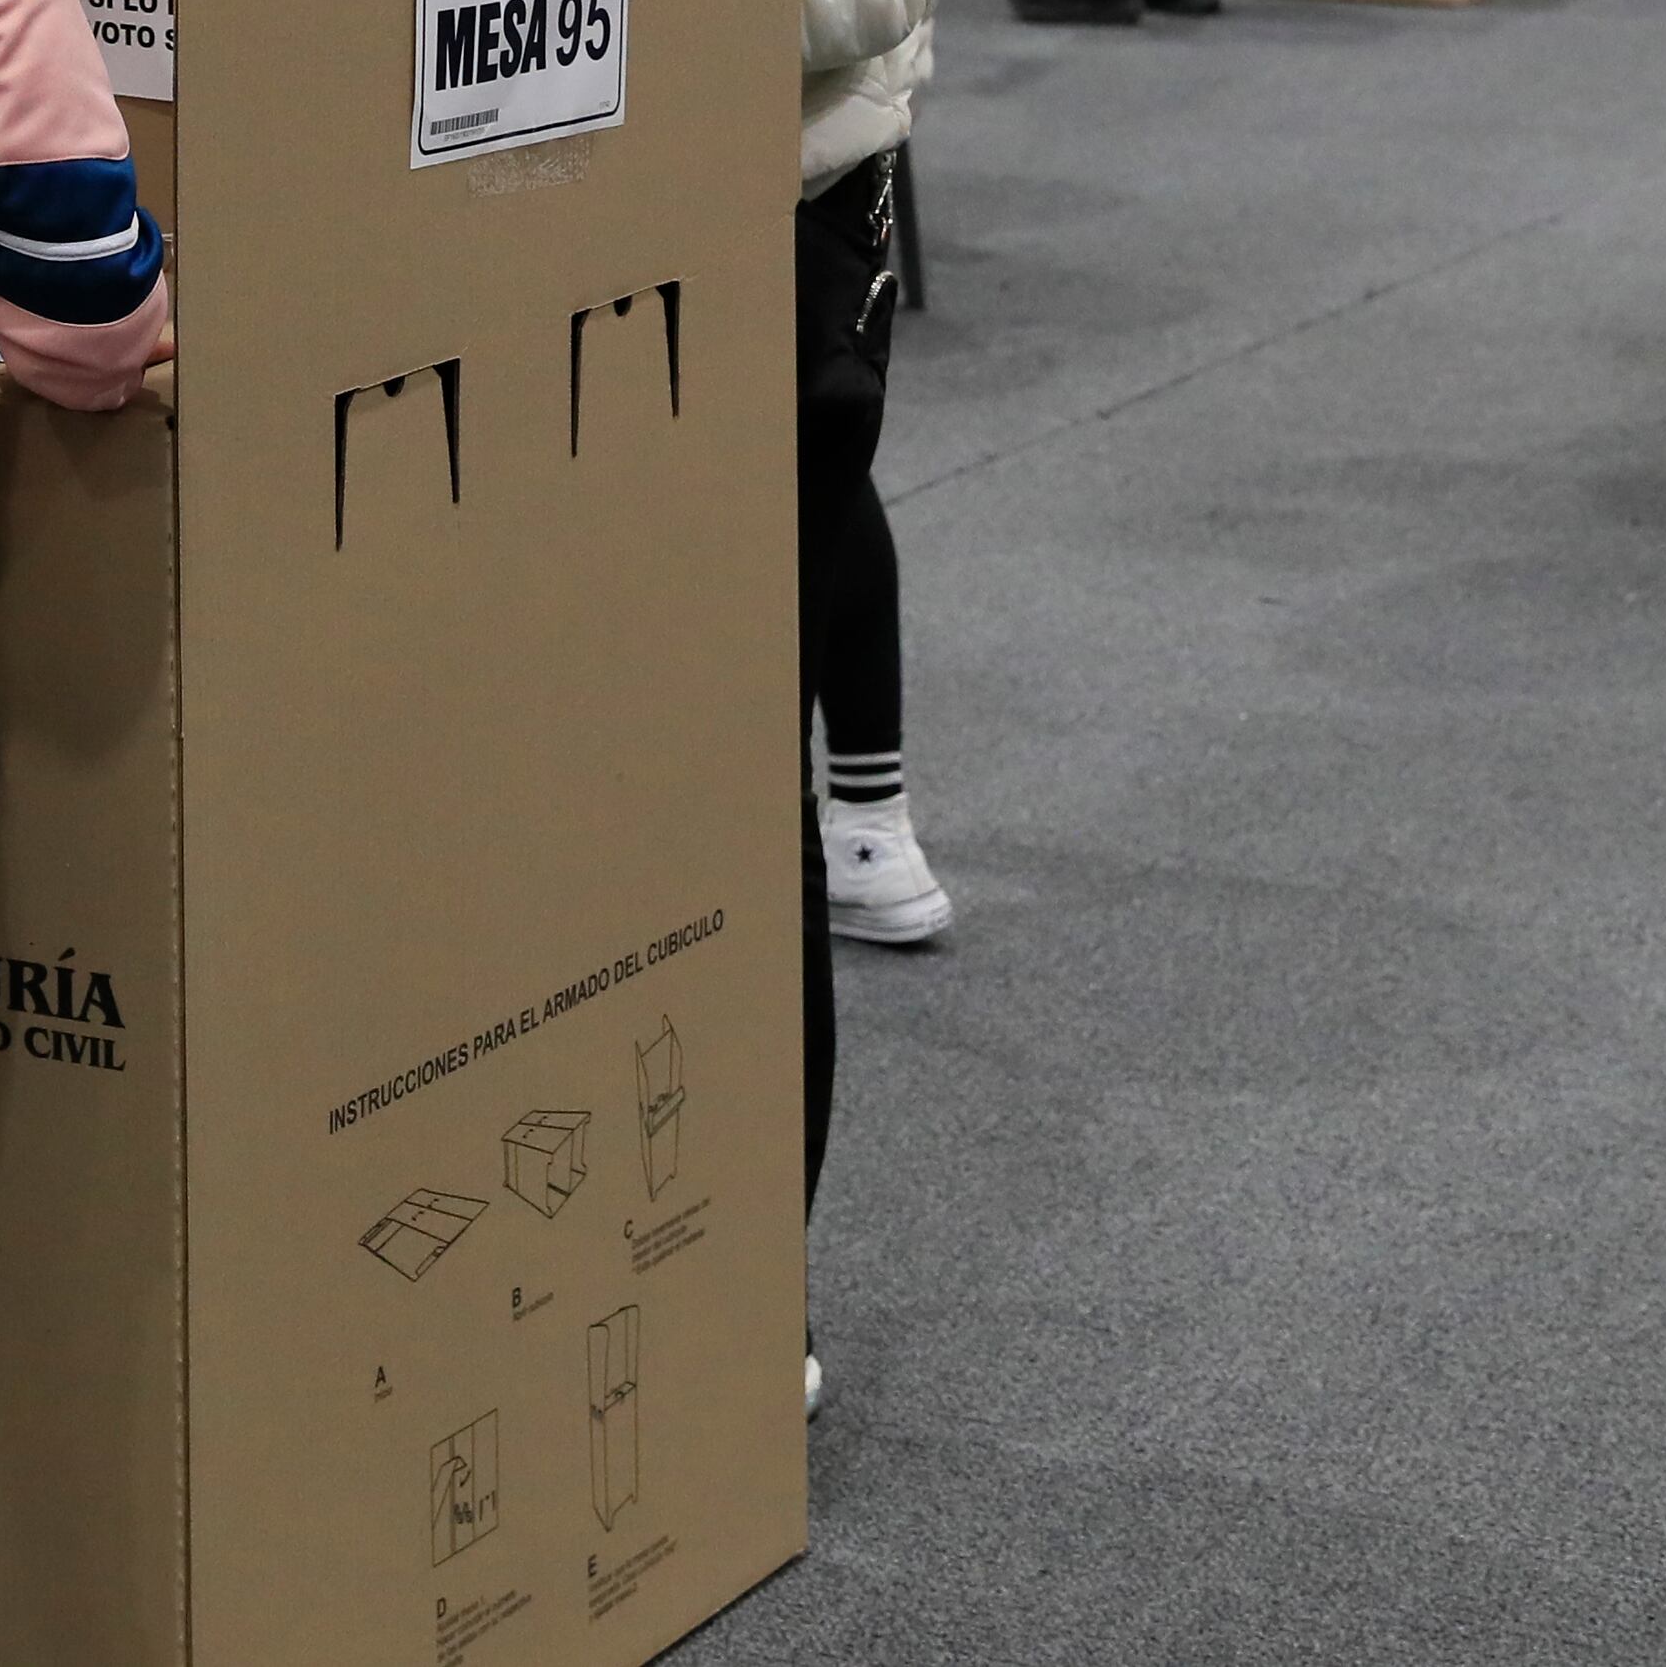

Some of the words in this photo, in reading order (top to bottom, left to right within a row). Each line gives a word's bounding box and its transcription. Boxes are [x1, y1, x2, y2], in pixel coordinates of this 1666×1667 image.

[329, 1043, 469, 1135] INSTRUCCIONES
[473, 1017, 517, 1060] PARA
[519, 1006, 540, 1035] EL
[542, 967, 610, 1024] ARMADO
[613, 951, 644, 985] DEL
[646, 908, 724, 966] CUBICULO
[24, 1027, 126, 1072] CIVIL
[624, 1219, 634, 1239] C
[512, 1286, 522, 1309] B
[375, 1366, 386, 1387] A
[588, 1553, 597, 1578] E
[437, 1597, 447, 1619] D
